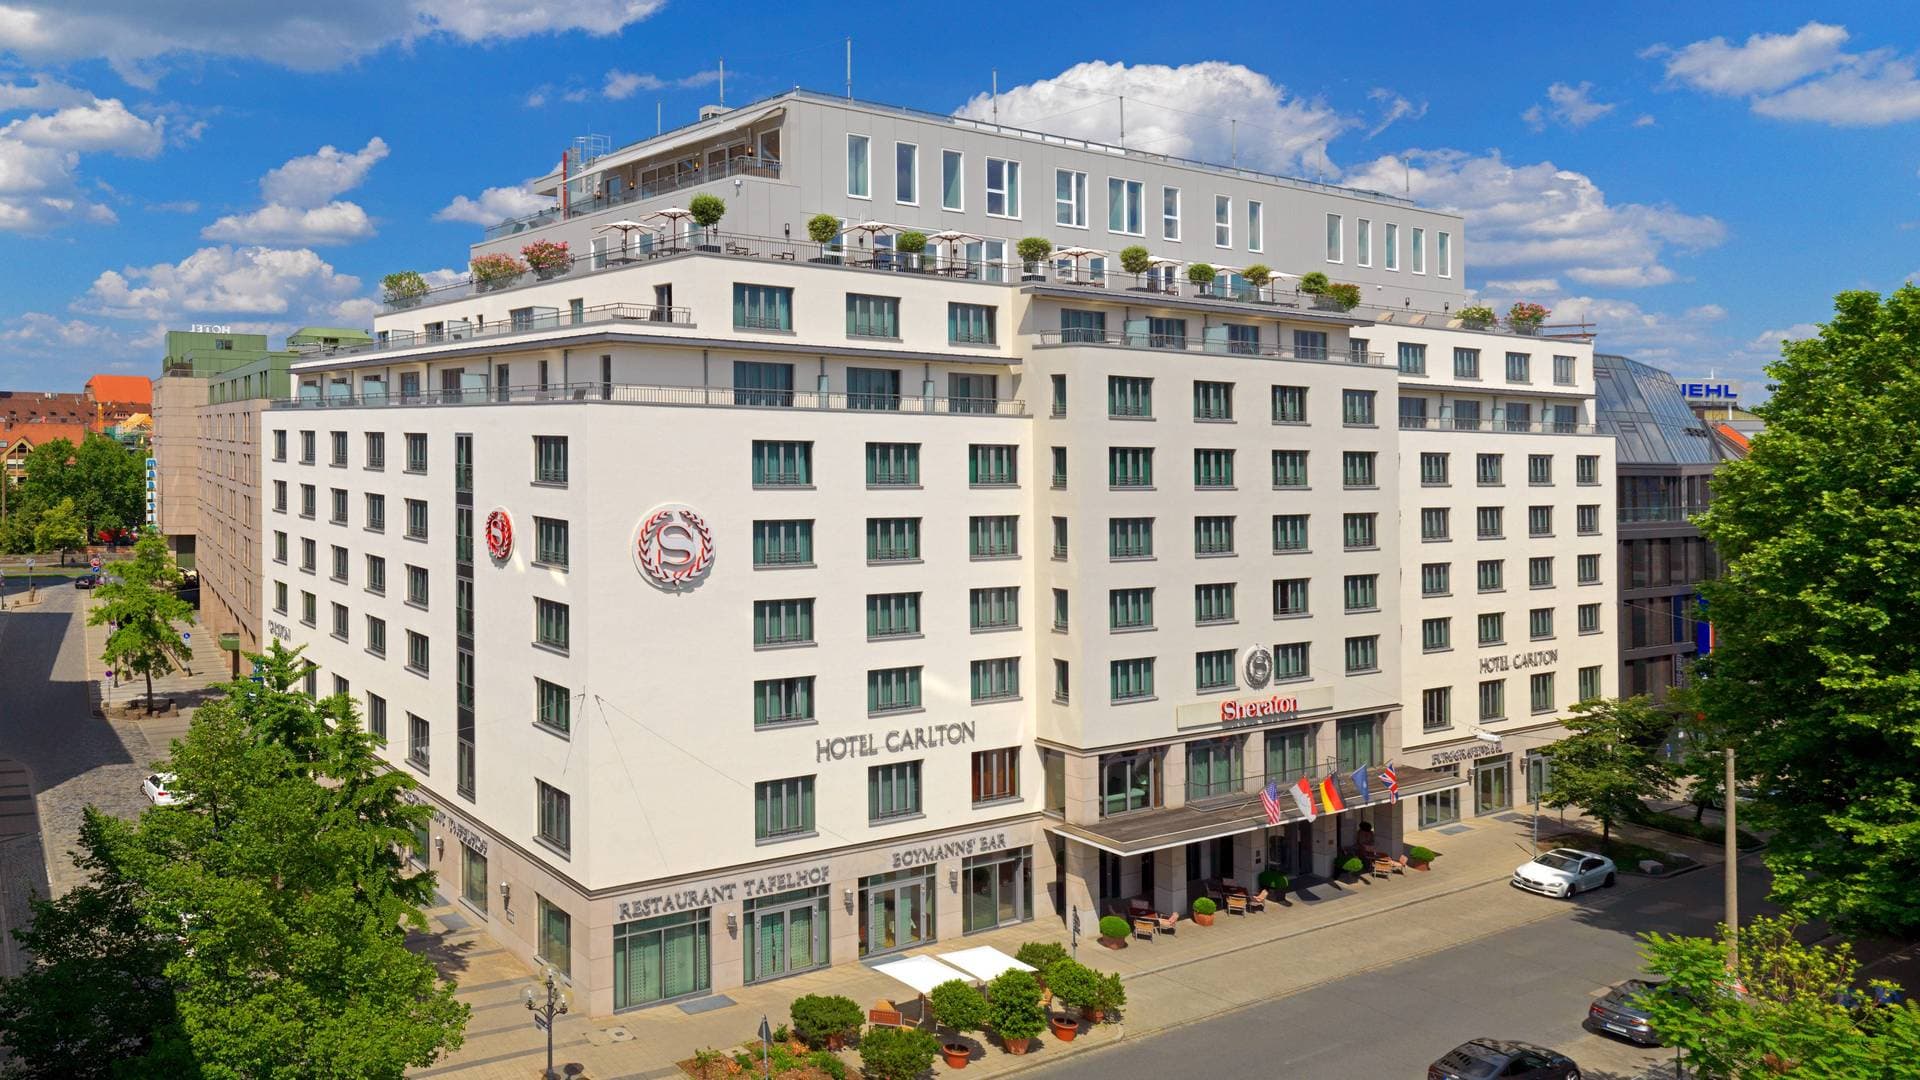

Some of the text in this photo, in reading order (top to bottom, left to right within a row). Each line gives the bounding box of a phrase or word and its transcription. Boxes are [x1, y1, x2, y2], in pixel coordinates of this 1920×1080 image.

[1680, 383, 1738, 399] IEHL
[656, 521, 697, 567] S
[1479, 648, 1558, 674] HOTEL CARLTON
[1221, 695, 1298, 721] Sheraton
[816, 720, 976, 763] HOTEL CARLTON
[979, 832, 1007, 852] BAR
[618, 865, 830, 921] RESTAURANT TAFELHOF
